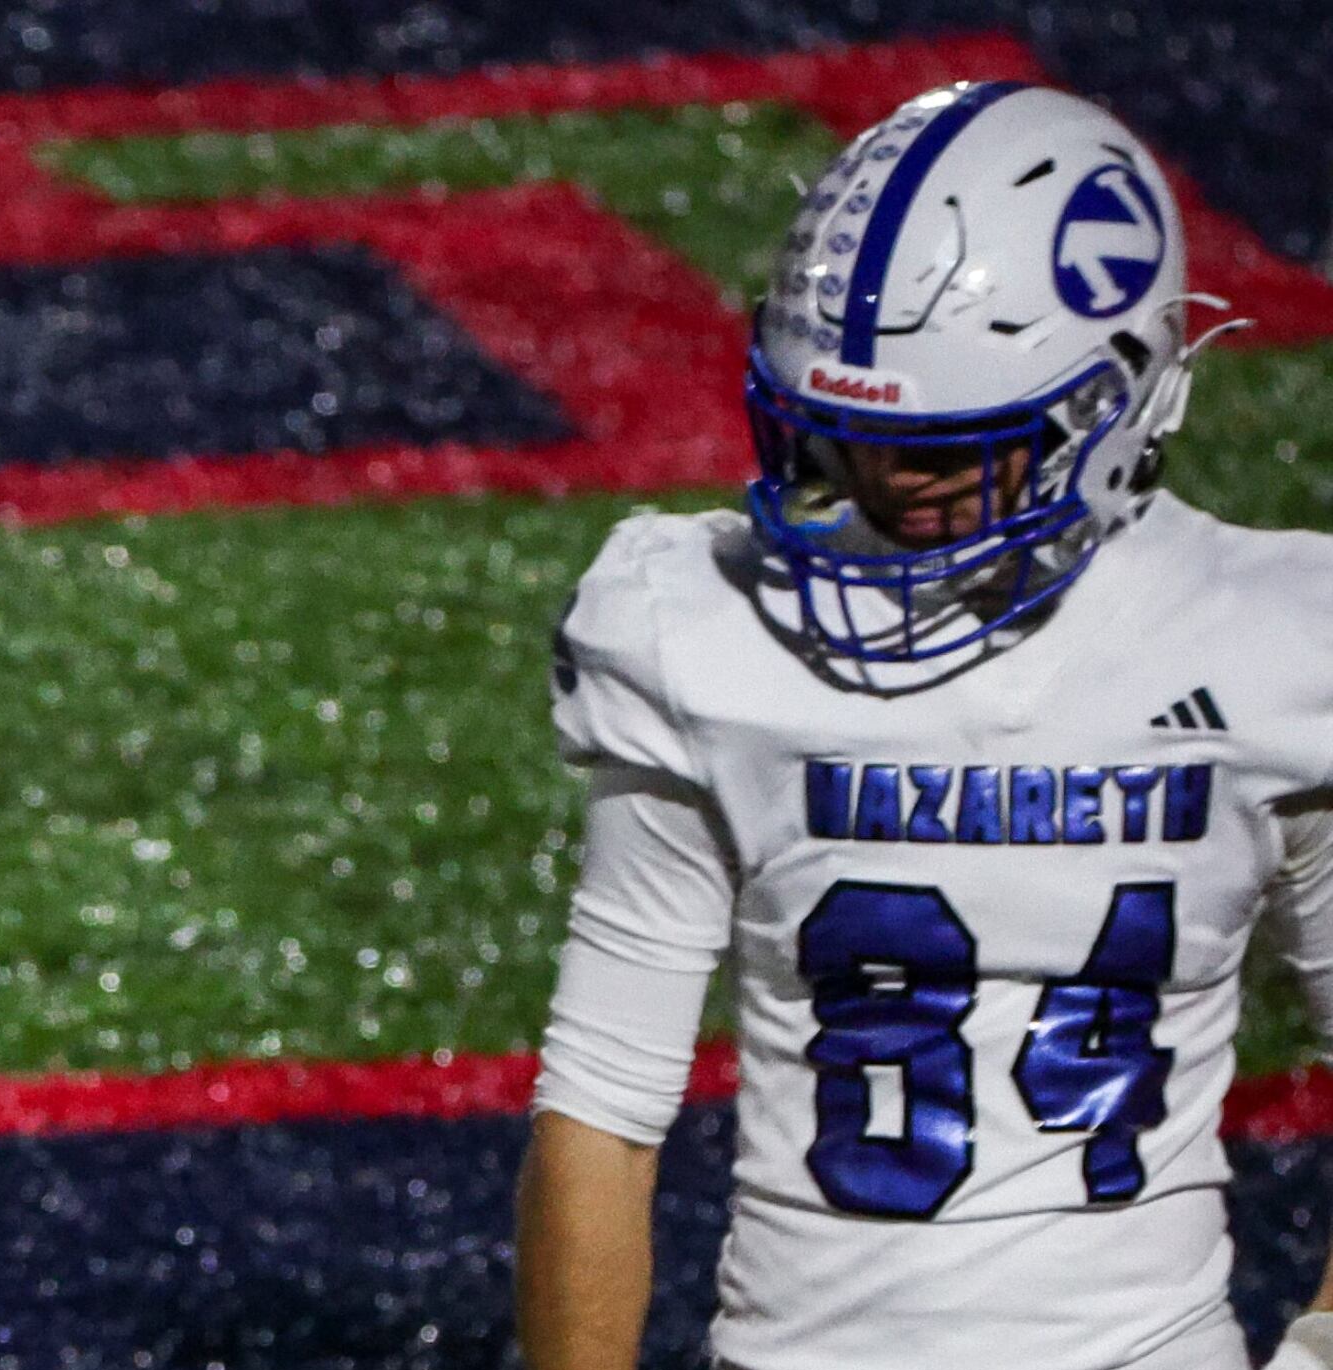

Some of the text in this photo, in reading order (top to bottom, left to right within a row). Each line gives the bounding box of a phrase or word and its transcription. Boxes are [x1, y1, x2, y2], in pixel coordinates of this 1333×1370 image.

[809, 367, 901, 403] Riddell
[805, 759, 1215, 846] NAZARETH
[797, 877, 1178, 1223] 84
